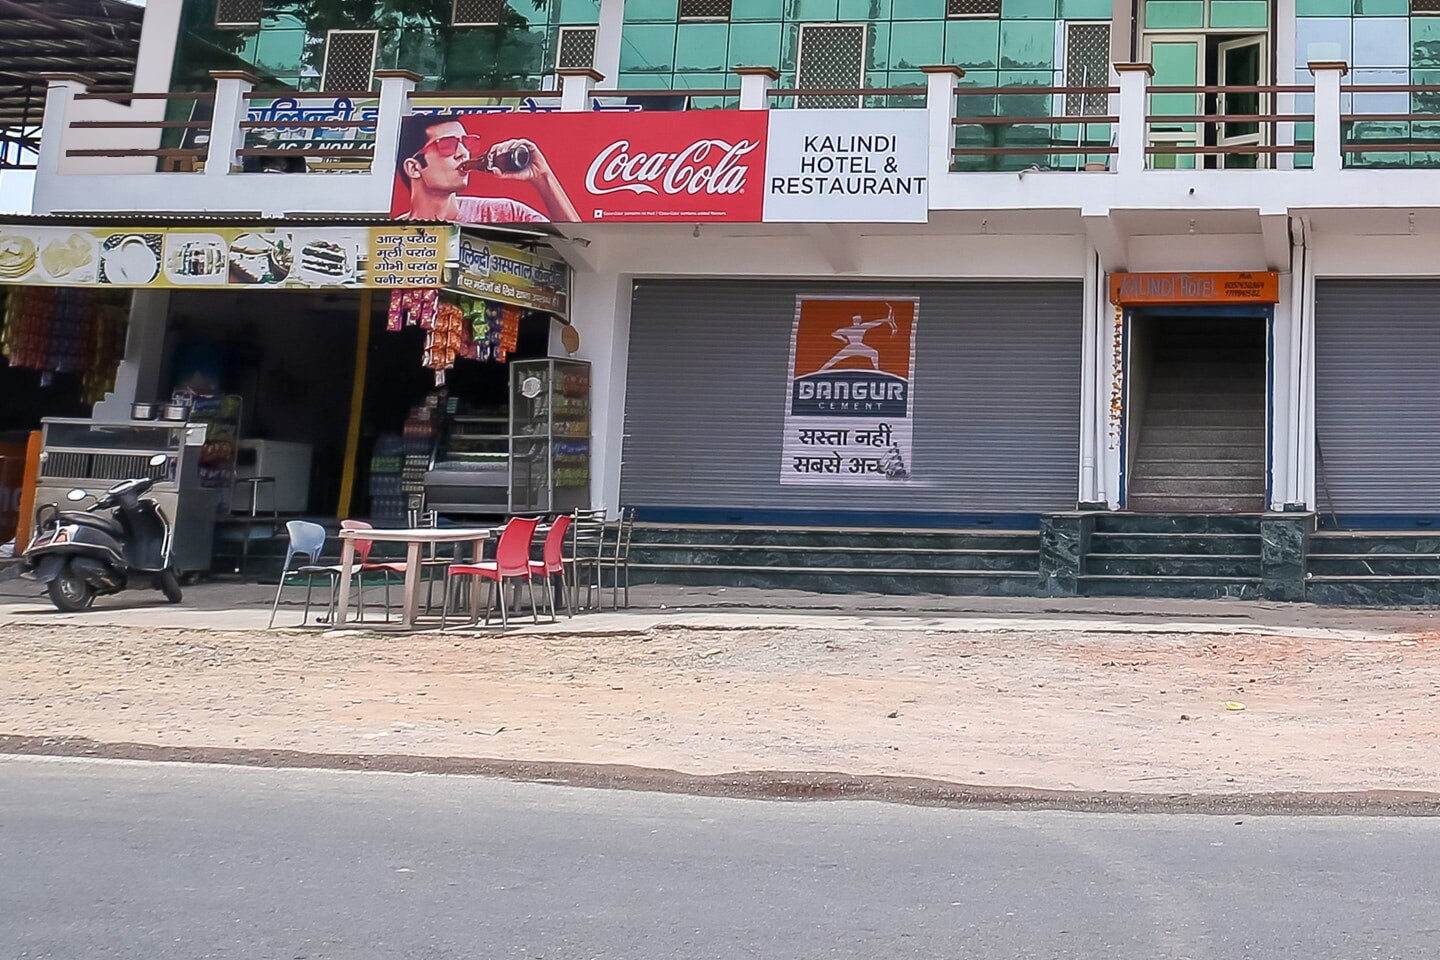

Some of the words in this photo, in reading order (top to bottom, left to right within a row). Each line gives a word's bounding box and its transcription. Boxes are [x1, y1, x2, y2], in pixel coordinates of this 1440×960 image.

[804, 135, 897, 153] KALINDI
[585, 139, 761, 196] Coca-Cola
[800, 156, 878, 174] HOTEL
[885, 156, 899, 174] &
[771, 177, 927, 195] RESTAURANT
[799, 381, 904, 401] BANGUR
[818, 402, 884, 410] CEMENT
[799, 428, 850, 446] सस्ता
[855, 422, 898, 448] नहीं,
[793, 451, 843, 473] सबसे
